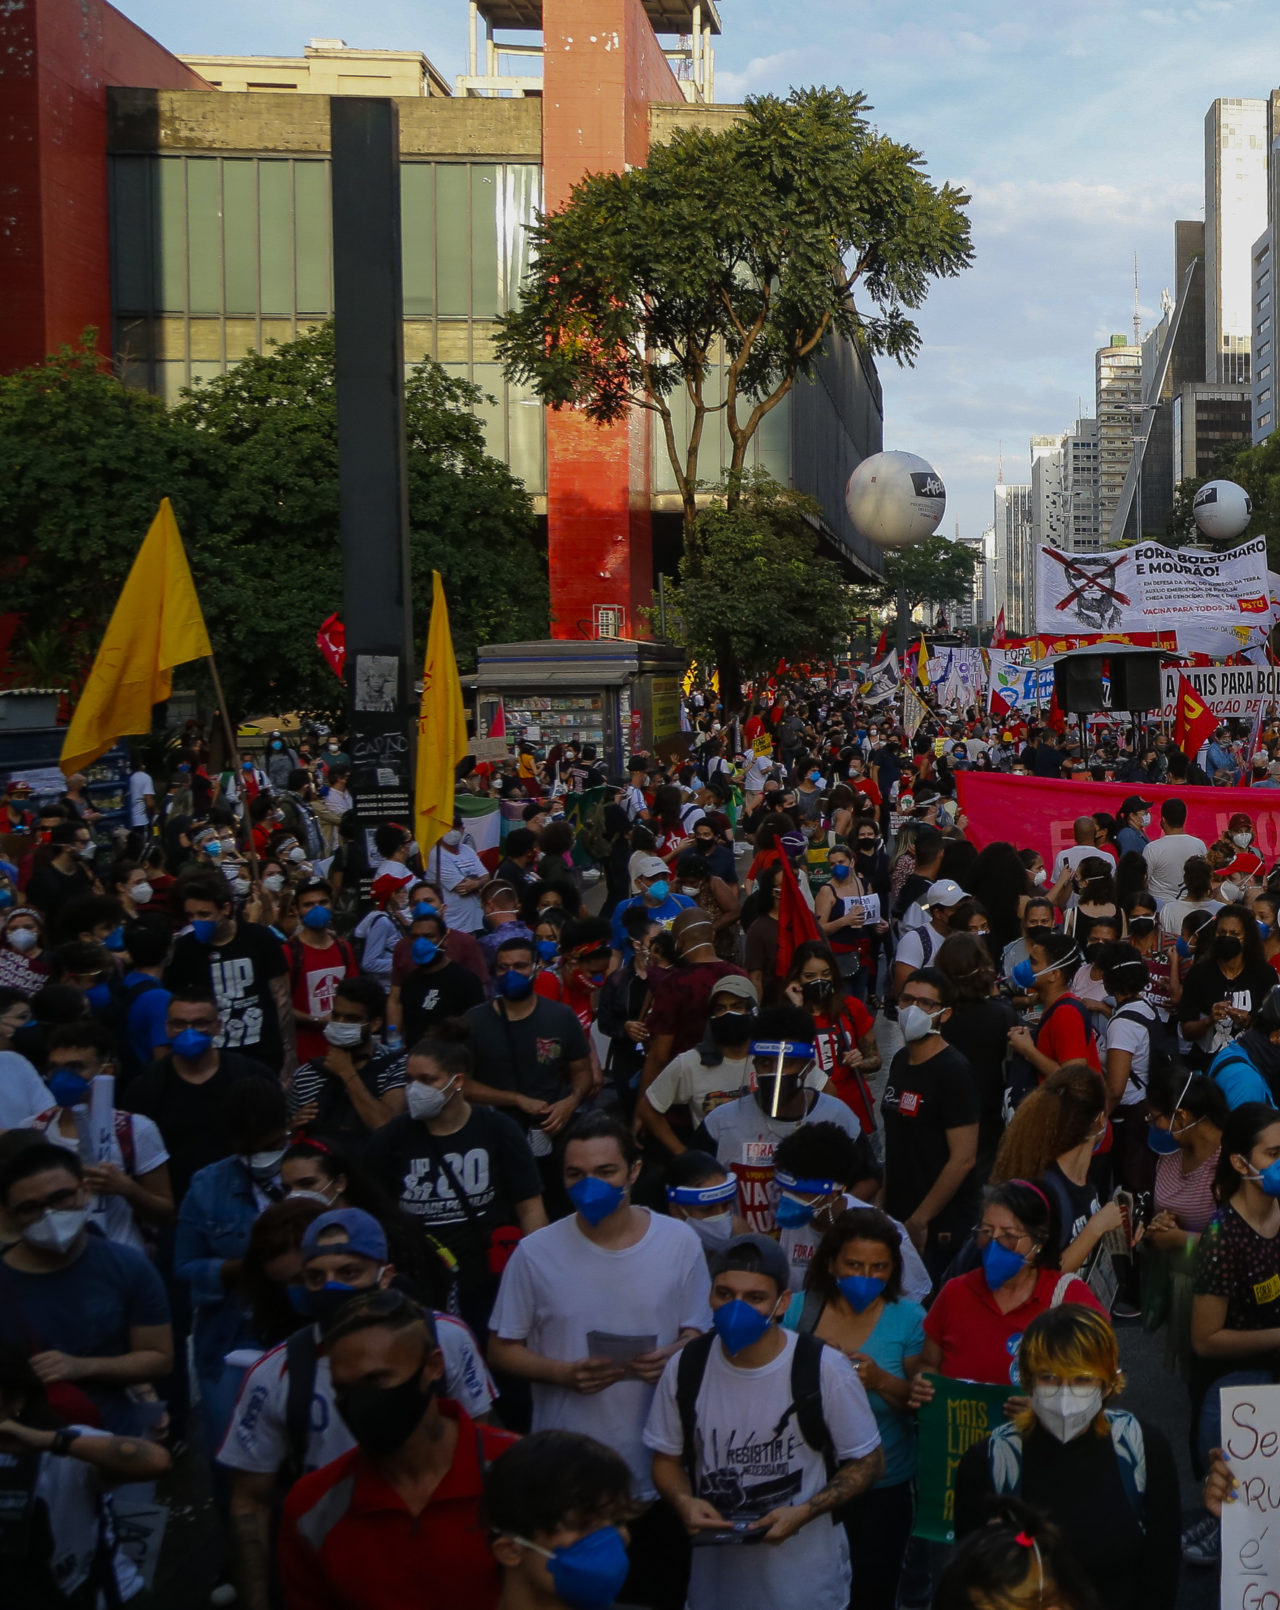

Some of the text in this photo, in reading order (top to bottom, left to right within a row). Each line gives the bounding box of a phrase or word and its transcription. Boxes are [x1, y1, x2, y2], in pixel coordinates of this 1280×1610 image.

[1135, 540, 1266, 564] FORA BOLSONARO
[1136, 562, 1220, 577] E MOURÃO!
[1241, 600, 1264, 609] PSTU
[1004, 648, 1031, 661] FORA
[1221, 672, 1253, 695] PARA
[211, 957, 255, 999] UP
[902, 1092, 918, 1107] FORA
[746, 1143, 774, 1156] FORA
[793, 1244, 813, 1258] FORA
[947, 1398, 988, 1428] MAIS
[1227, 1402, 1279, 1460] Se
[727, 1440, 783, 1465] RESISTIR
[1239, 1526, 1269, 1571] é
